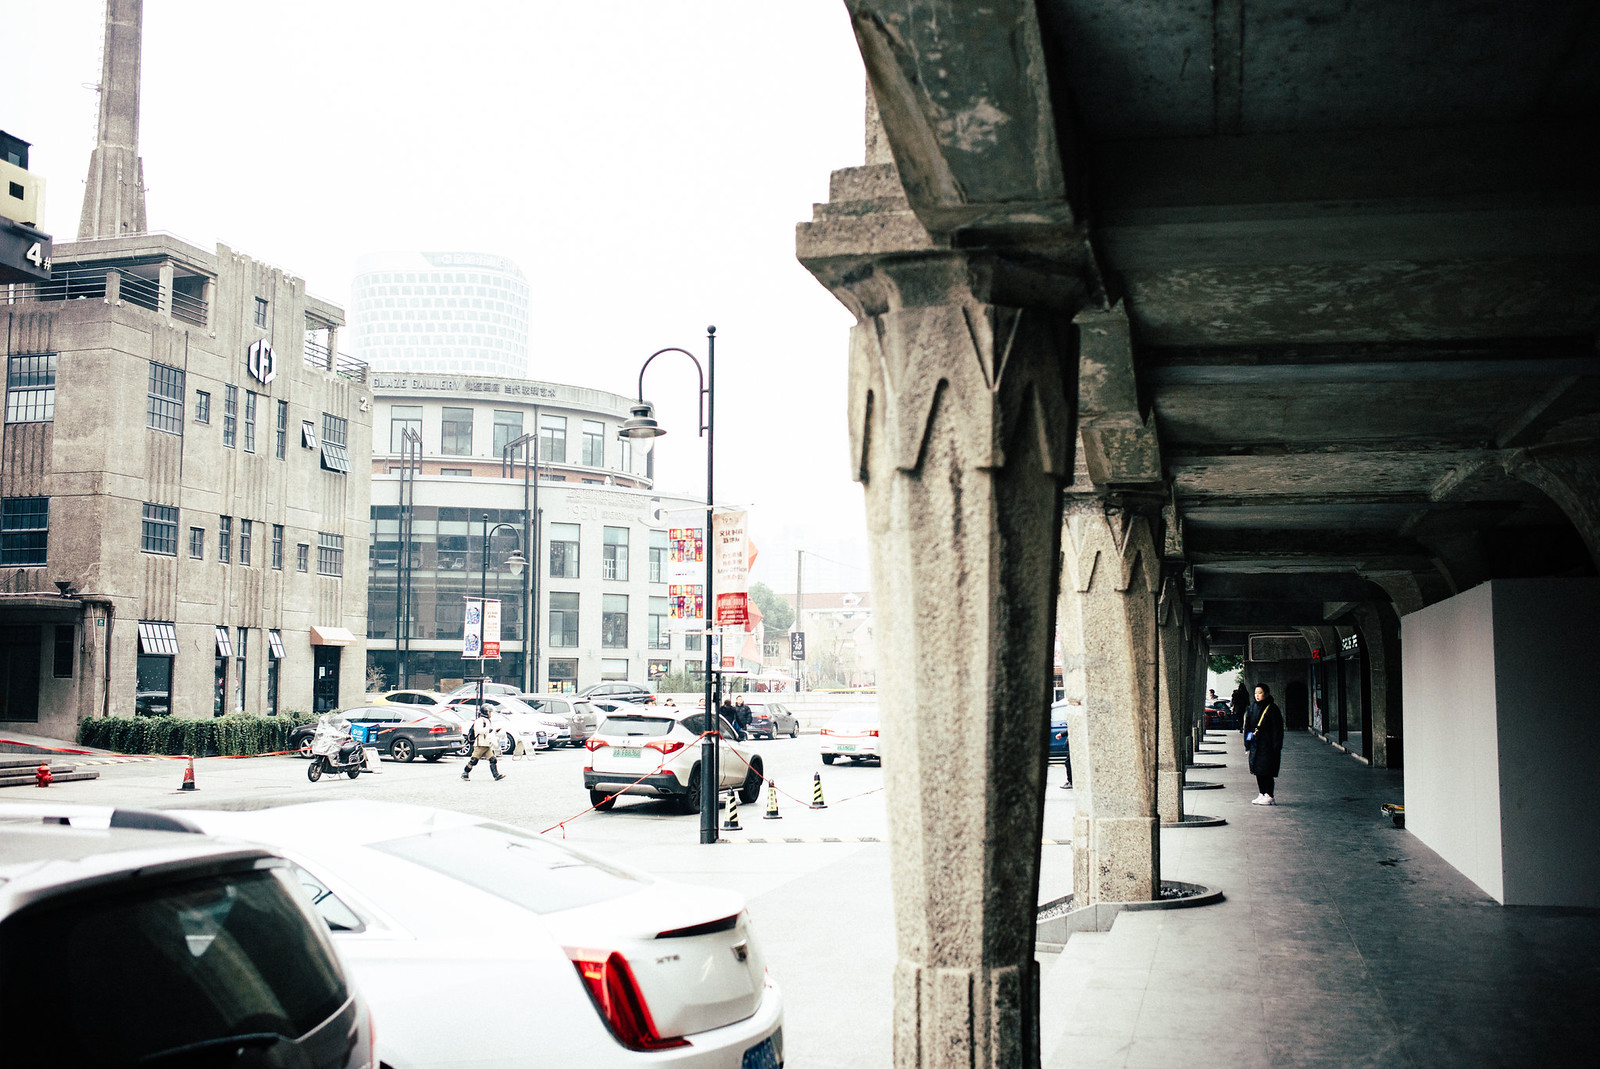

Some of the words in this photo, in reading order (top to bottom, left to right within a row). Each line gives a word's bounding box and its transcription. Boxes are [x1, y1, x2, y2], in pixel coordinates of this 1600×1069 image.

[26, 242, 51, 270] 4#
[372, 377, 407, 389] GLAZE
[411, 379, 460, 391] GALLERY
